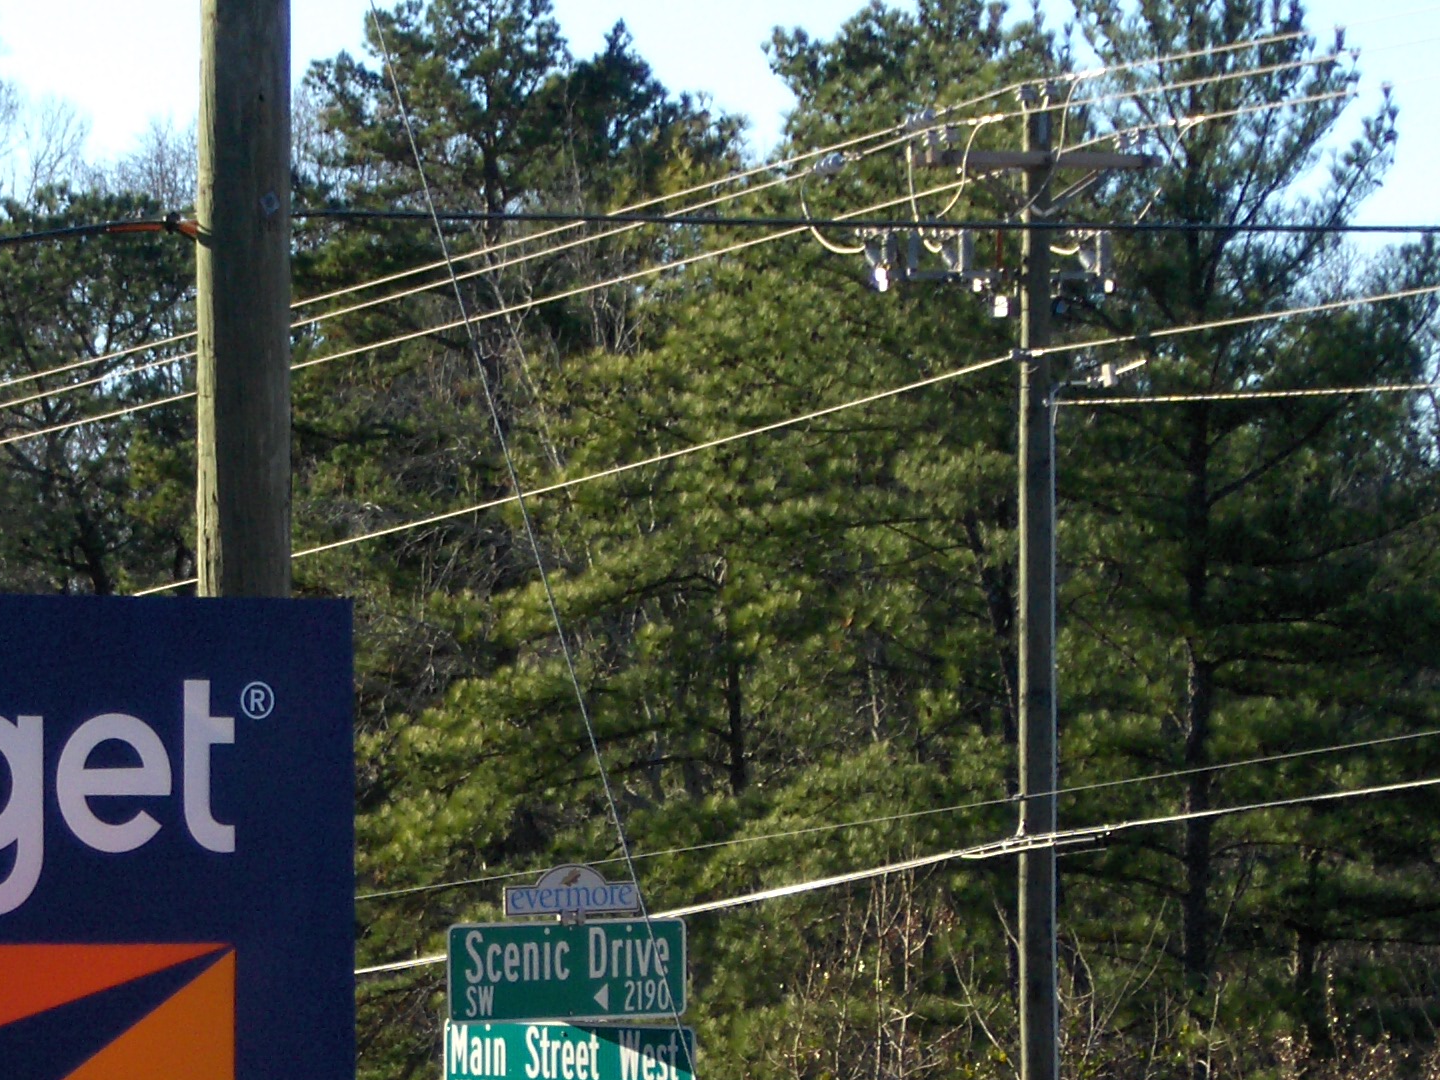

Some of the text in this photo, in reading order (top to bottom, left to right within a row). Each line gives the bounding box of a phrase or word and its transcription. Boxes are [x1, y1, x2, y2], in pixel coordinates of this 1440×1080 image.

[511, 884, 632, 910] evermore
[465, 926, 670, 984] Scenic Drive
[465, 979, 669, 1018] SW 2190
[451, 1024, 507, 1077] Main
